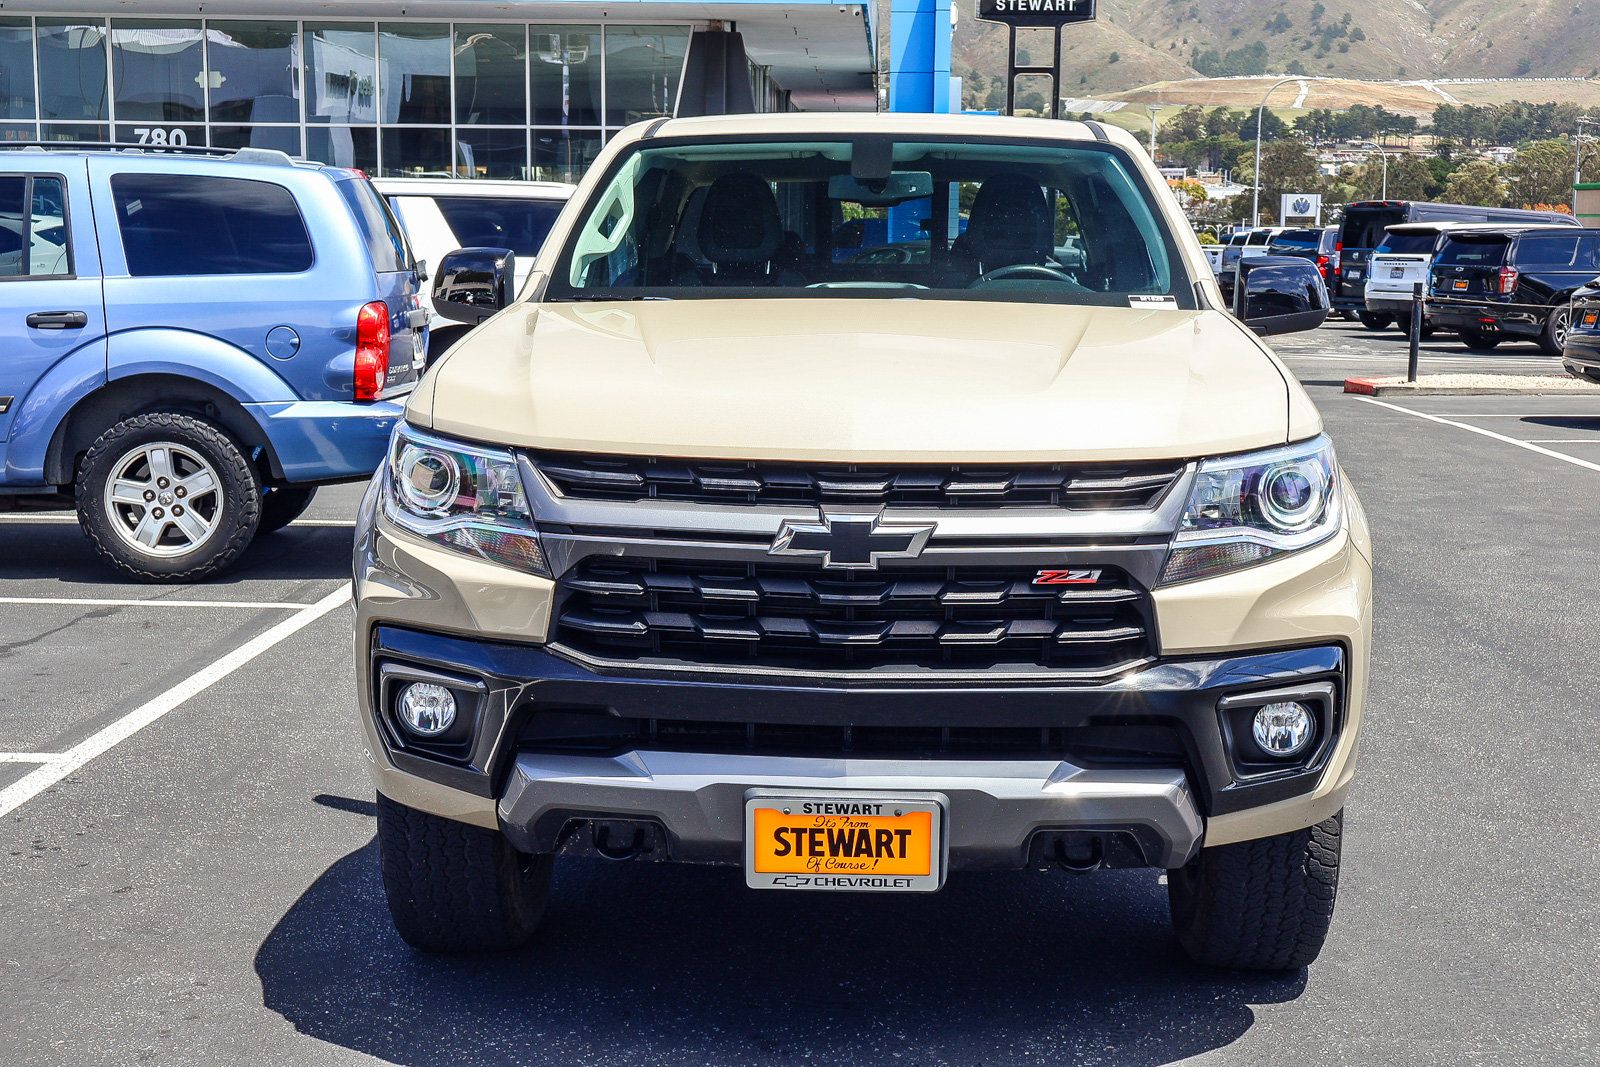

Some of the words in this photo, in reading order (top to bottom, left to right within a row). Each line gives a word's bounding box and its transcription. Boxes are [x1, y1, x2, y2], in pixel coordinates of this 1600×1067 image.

[996, 0, 1075, 11] STEWART
[134, 128, 187, 153] 780
[803, 802, 883, 816] STEWART
[839, 816, 871, 829] From
[773, 826, 912, 859] STEWART
[806, 856, 821, 872] Of
[814, 877, 914, 888] CHEVROLET
